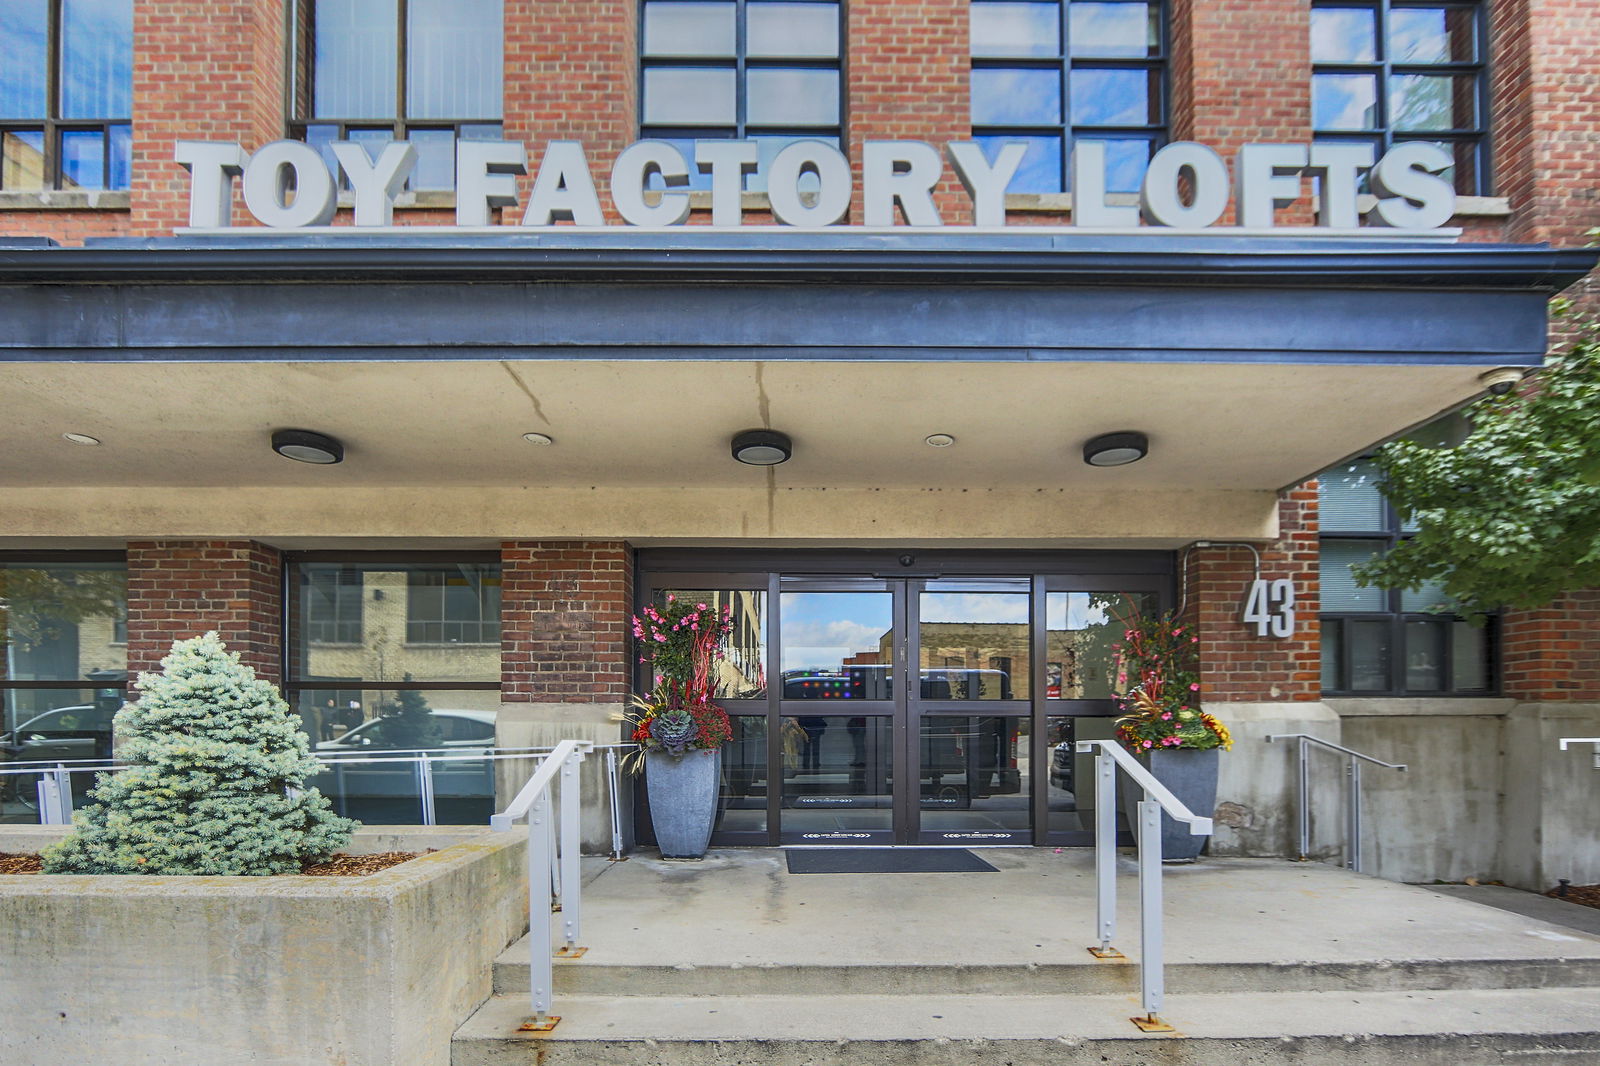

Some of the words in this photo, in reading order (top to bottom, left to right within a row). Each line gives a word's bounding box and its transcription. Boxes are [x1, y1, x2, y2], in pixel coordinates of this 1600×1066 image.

[175, 139, 418, 228] TOY
[456, 138, 1029, 228] FACTORY
[1071, 140, 1456, 229] LOFTS
[1243, 578, 1295, 638] 43
